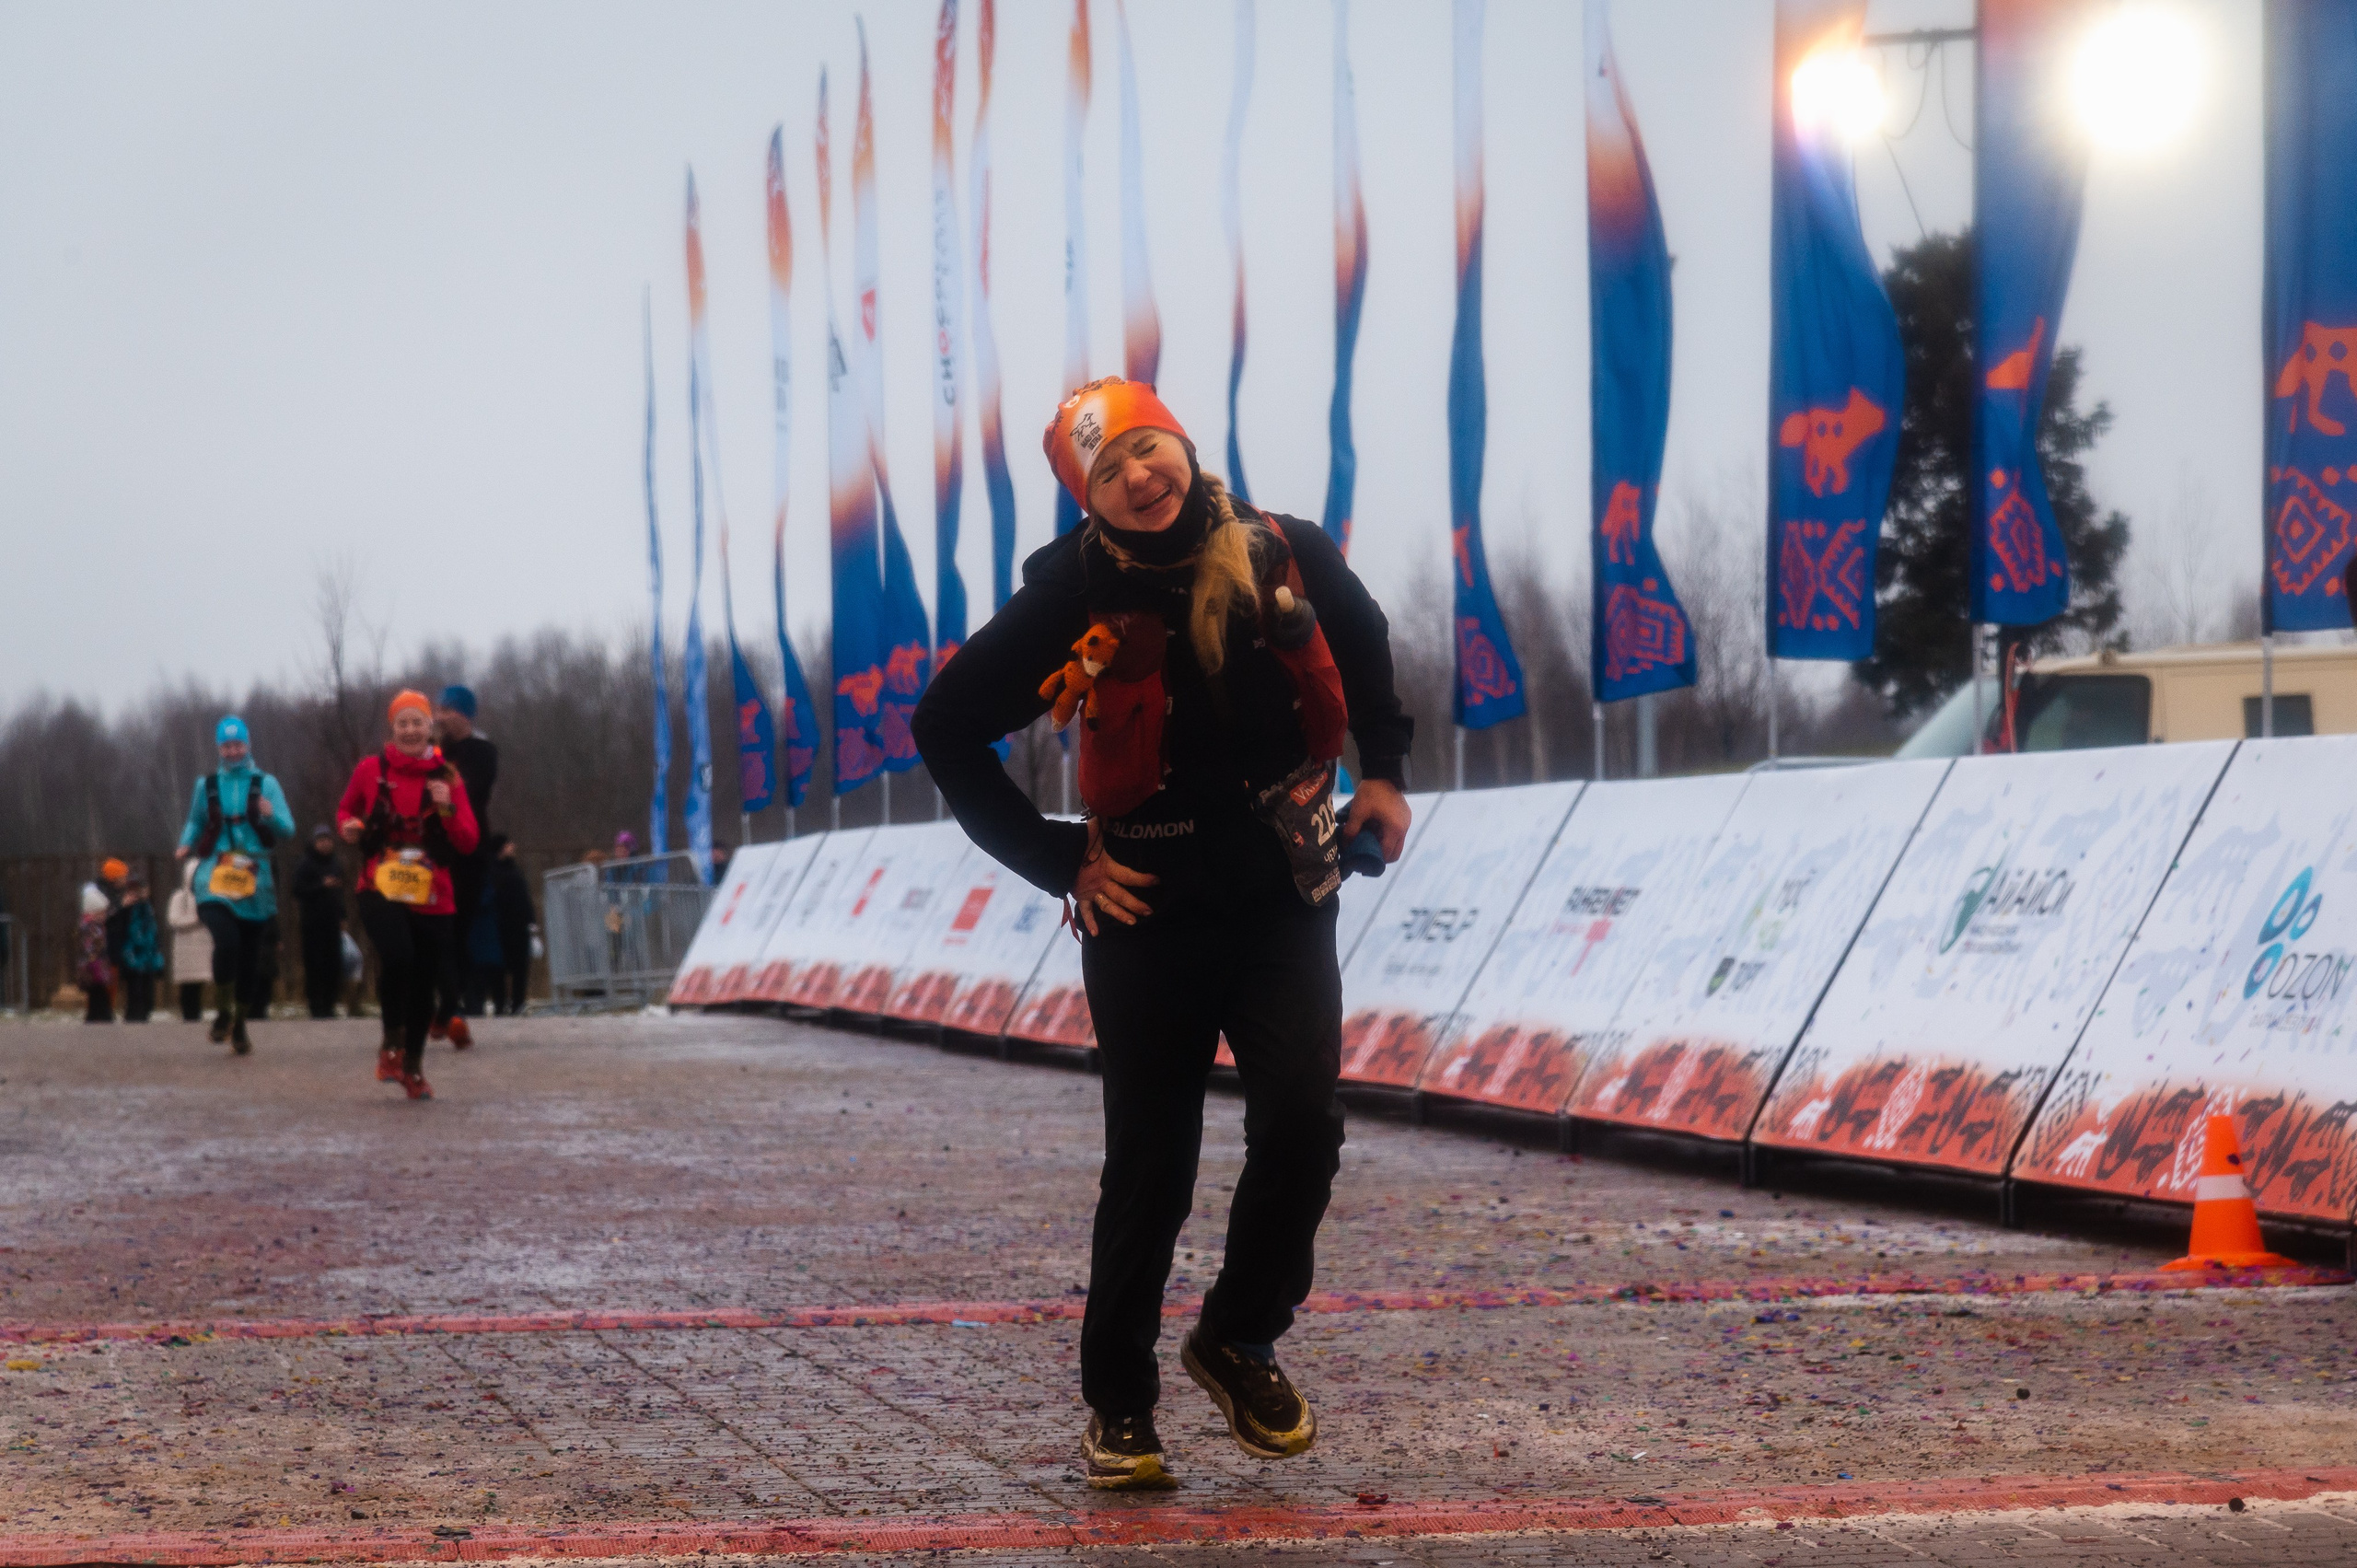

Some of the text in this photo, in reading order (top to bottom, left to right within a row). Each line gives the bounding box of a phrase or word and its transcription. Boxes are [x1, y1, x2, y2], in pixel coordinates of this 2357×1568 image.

[1081, 424, 1101, 448] MAD FOX
[1107, 819, 1195, 839] ALOMON
[2267, 952, 2357, 1001] OZON
